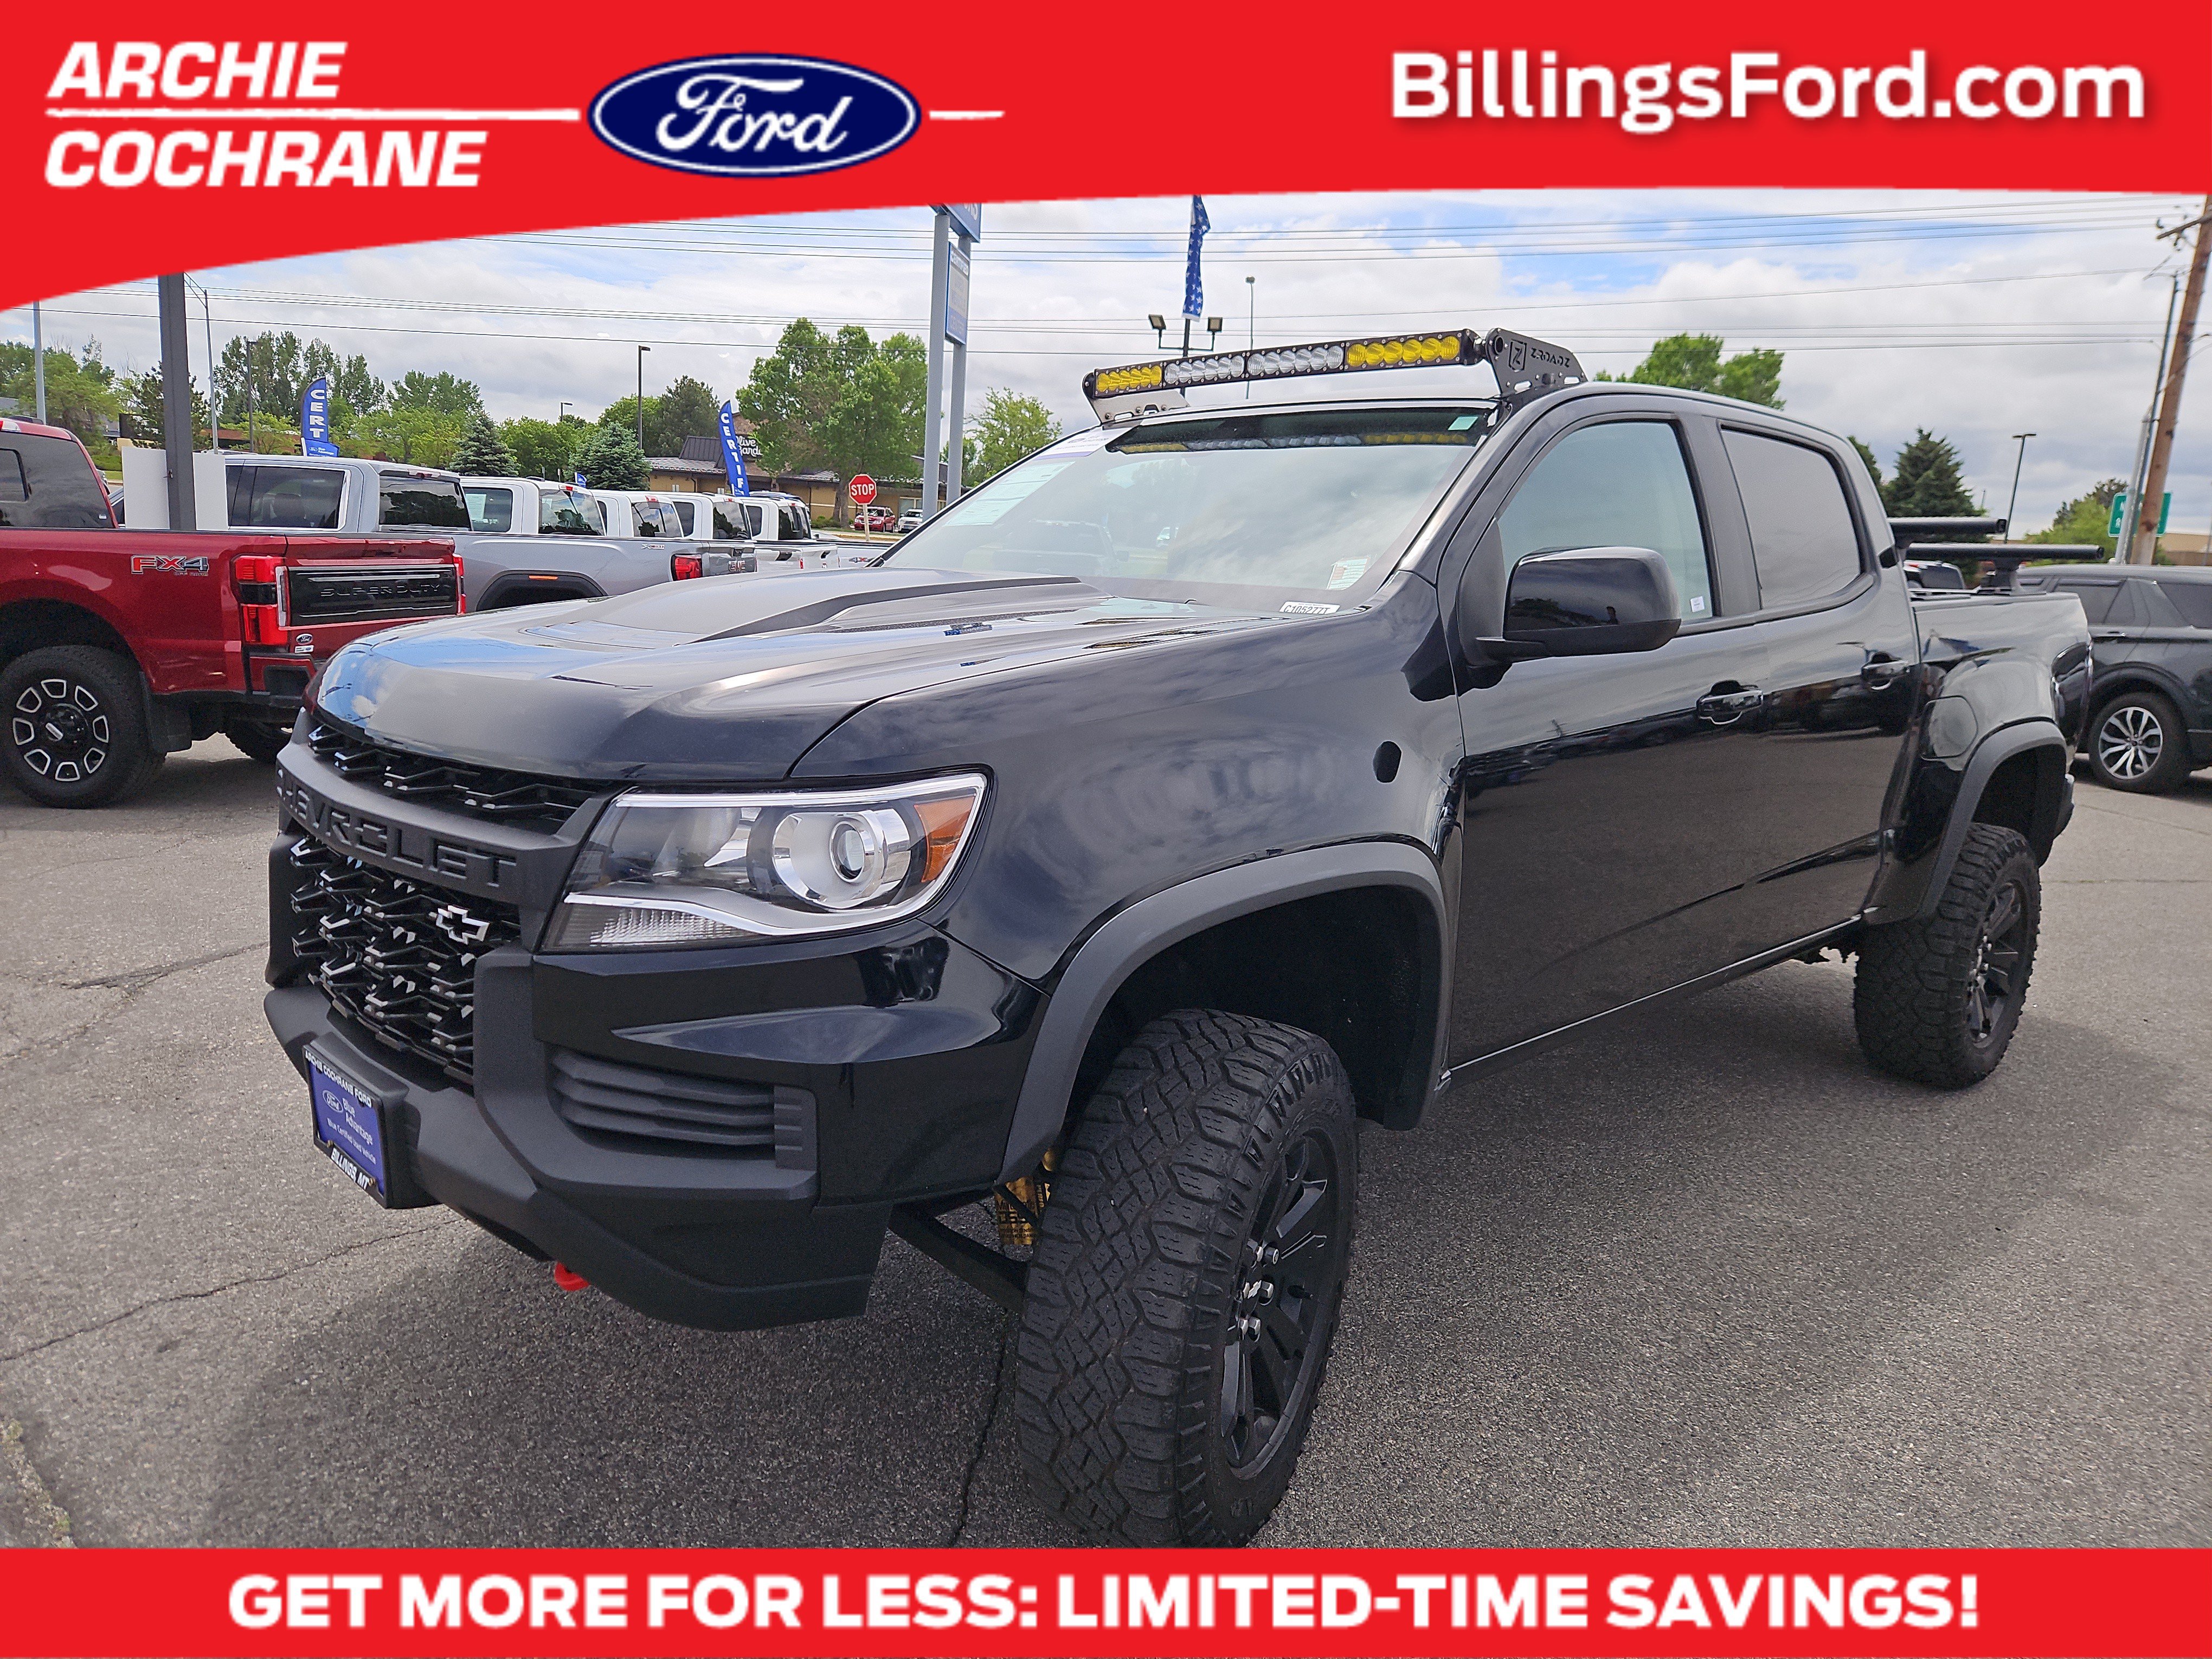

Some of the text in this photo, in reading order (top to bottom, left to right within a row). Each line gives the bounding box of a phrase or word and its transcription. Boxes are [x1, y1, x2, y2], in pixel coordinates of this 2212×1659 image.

[310, 389, 326, 438] CERT
[851, 484, 874, 496] STOP
[131, 555, 209, 574] FX4
[320, 584, 440, 596] SUPER DUTY
[275, 767, 517, 888] CHEVROLET
[324, 1065, 353, 1096] COCHRANE
[355, 1088, 372, 1108] FORD
[343, 1098, 356, 1117] Blue
[345, 1112, 373, 1146] Advantage
[357, 1172, 370, 1190] MT
